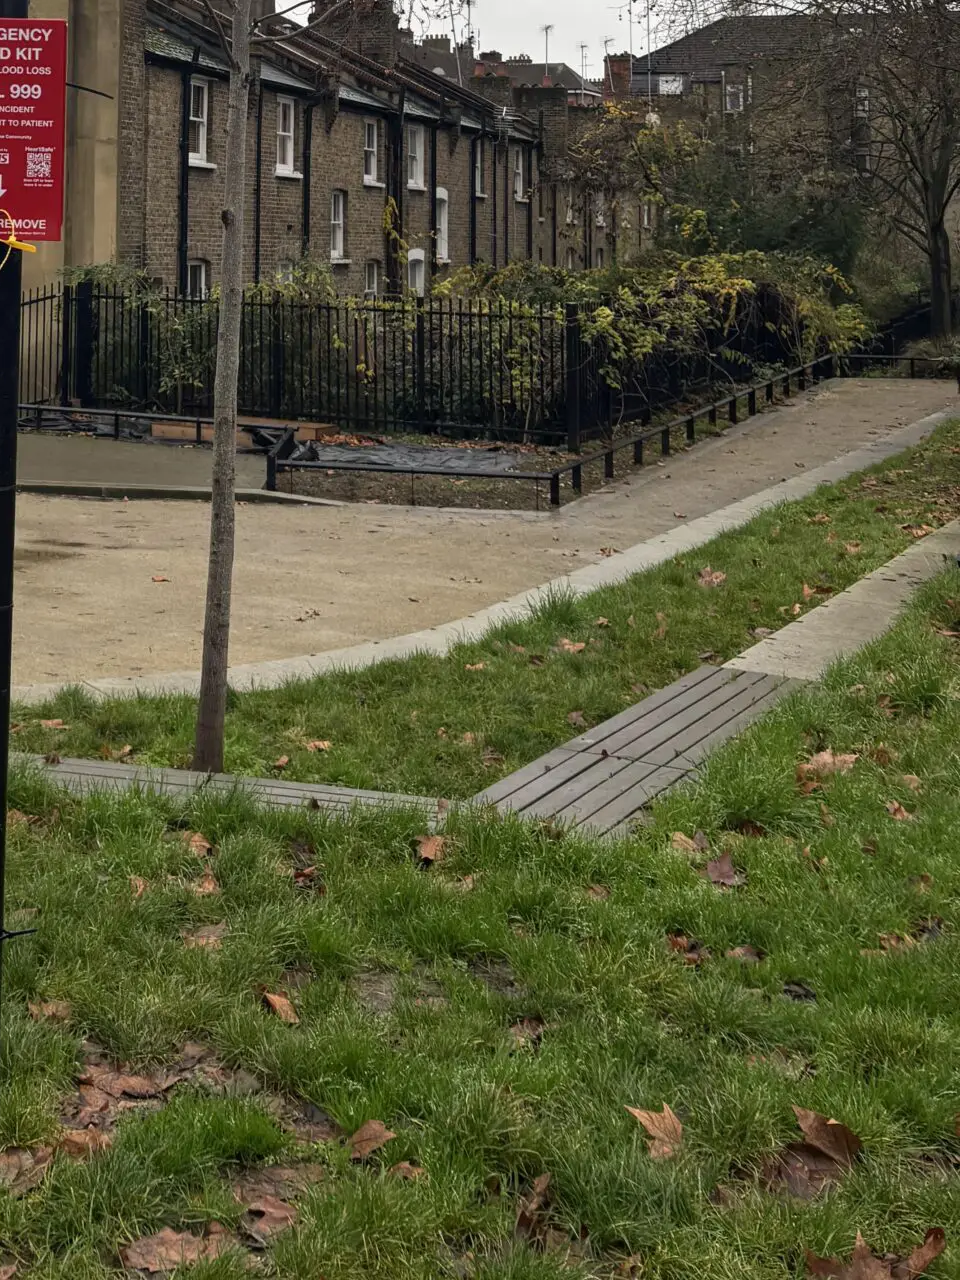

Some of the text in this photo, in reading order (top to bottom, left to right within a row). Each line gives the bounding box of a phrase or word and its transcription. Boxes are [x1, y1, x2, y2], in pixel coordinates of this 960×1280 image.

[15, 47, 43, 61] KIT
[26, 66, 52, 75] LOSS
[9, 84, 42, 99] 999
[8, 119, 19, 127] TO
[21, 119, 54, 128] PATIENT
